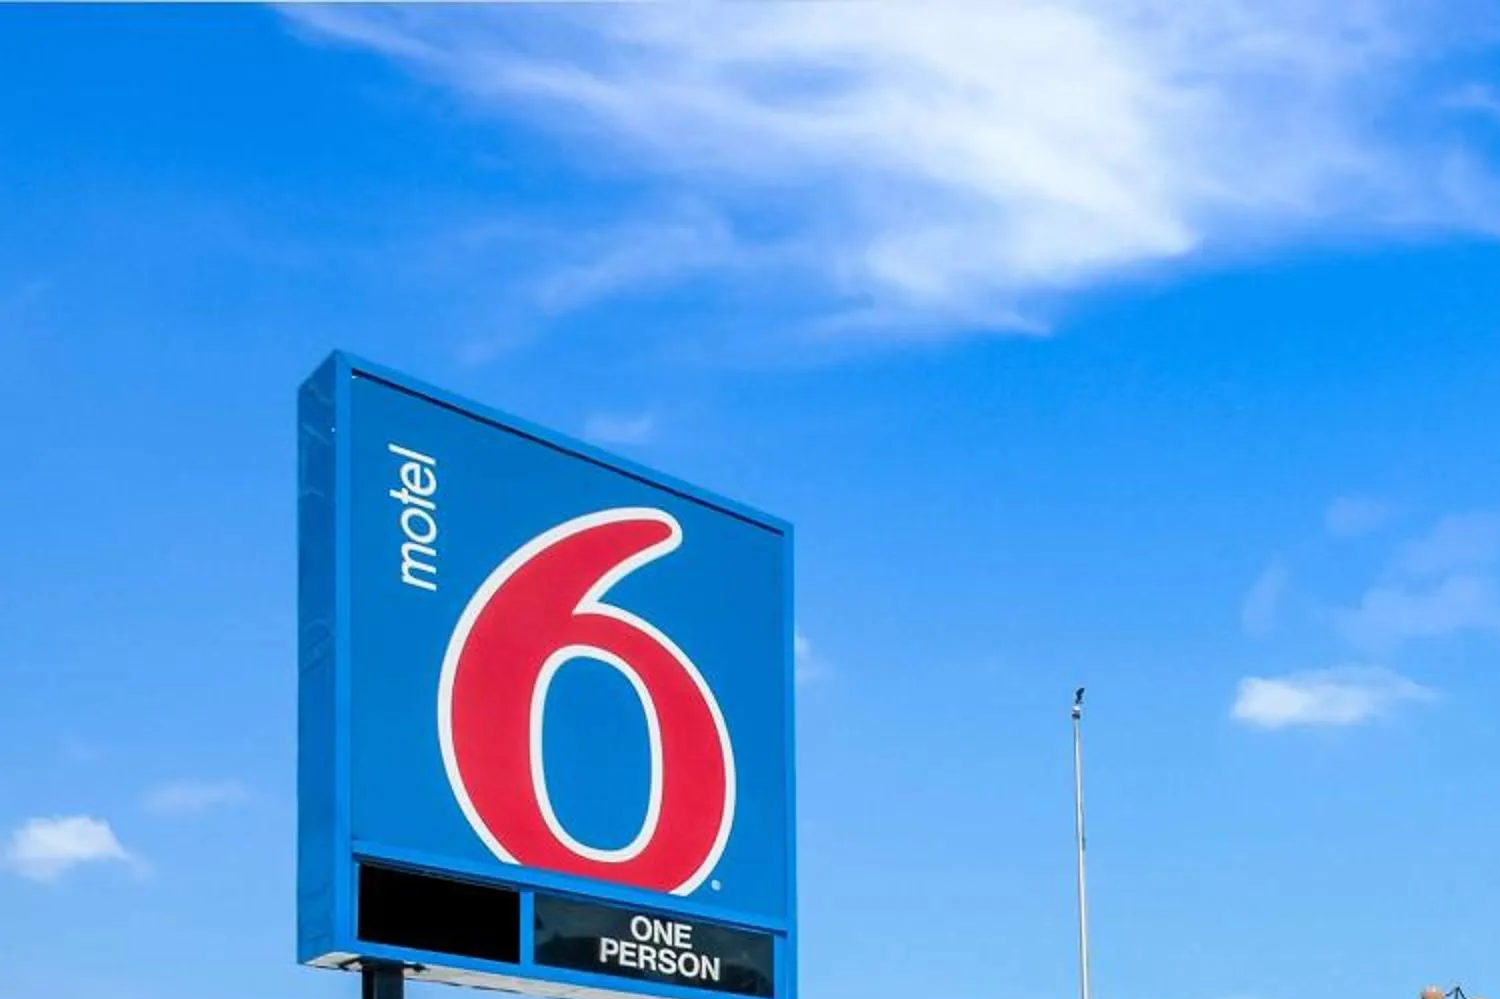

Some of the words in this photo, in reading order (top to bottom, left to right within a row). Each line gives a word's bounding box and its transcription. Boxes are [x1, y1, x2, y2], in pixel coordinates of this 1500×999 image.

[389, 444, 437, 591] motel
[437, 507, 736, 897] 6
[599, 937, 721, 982] PERSON
[630, 915, 693, 950] ONE
